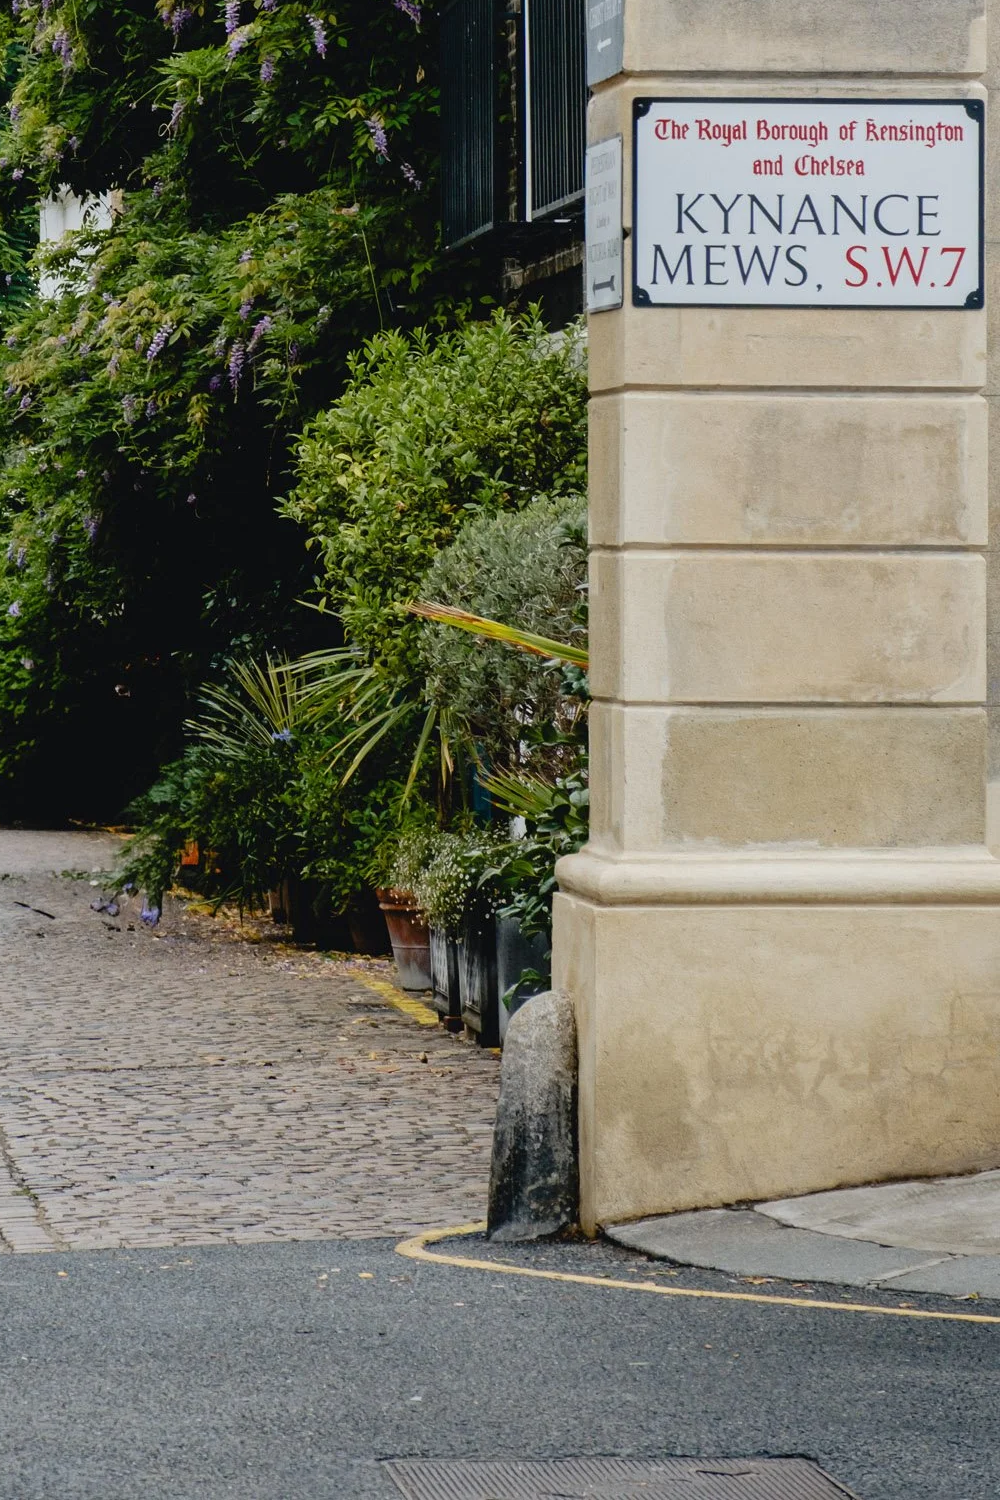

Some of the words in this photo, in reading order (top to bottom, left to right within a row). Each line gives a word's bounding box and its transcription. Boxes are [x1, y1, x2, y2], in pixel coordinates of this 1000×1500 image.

[654, 119, 690, 141] The
[695, 119, 748, 147] Royal
[756, 119, 829, 148] Borough
[839, 121, 858, 141] of
[865, 118, 965, 148] Kensington
[753, 155, 784, 176] and
[794, 155, 866, 176] Chelsea
[675, 193, 943, 237] KYNANCE
[650, 244, 824, 293] MEWS,
[845, 245, 968, 288] S.W.7
